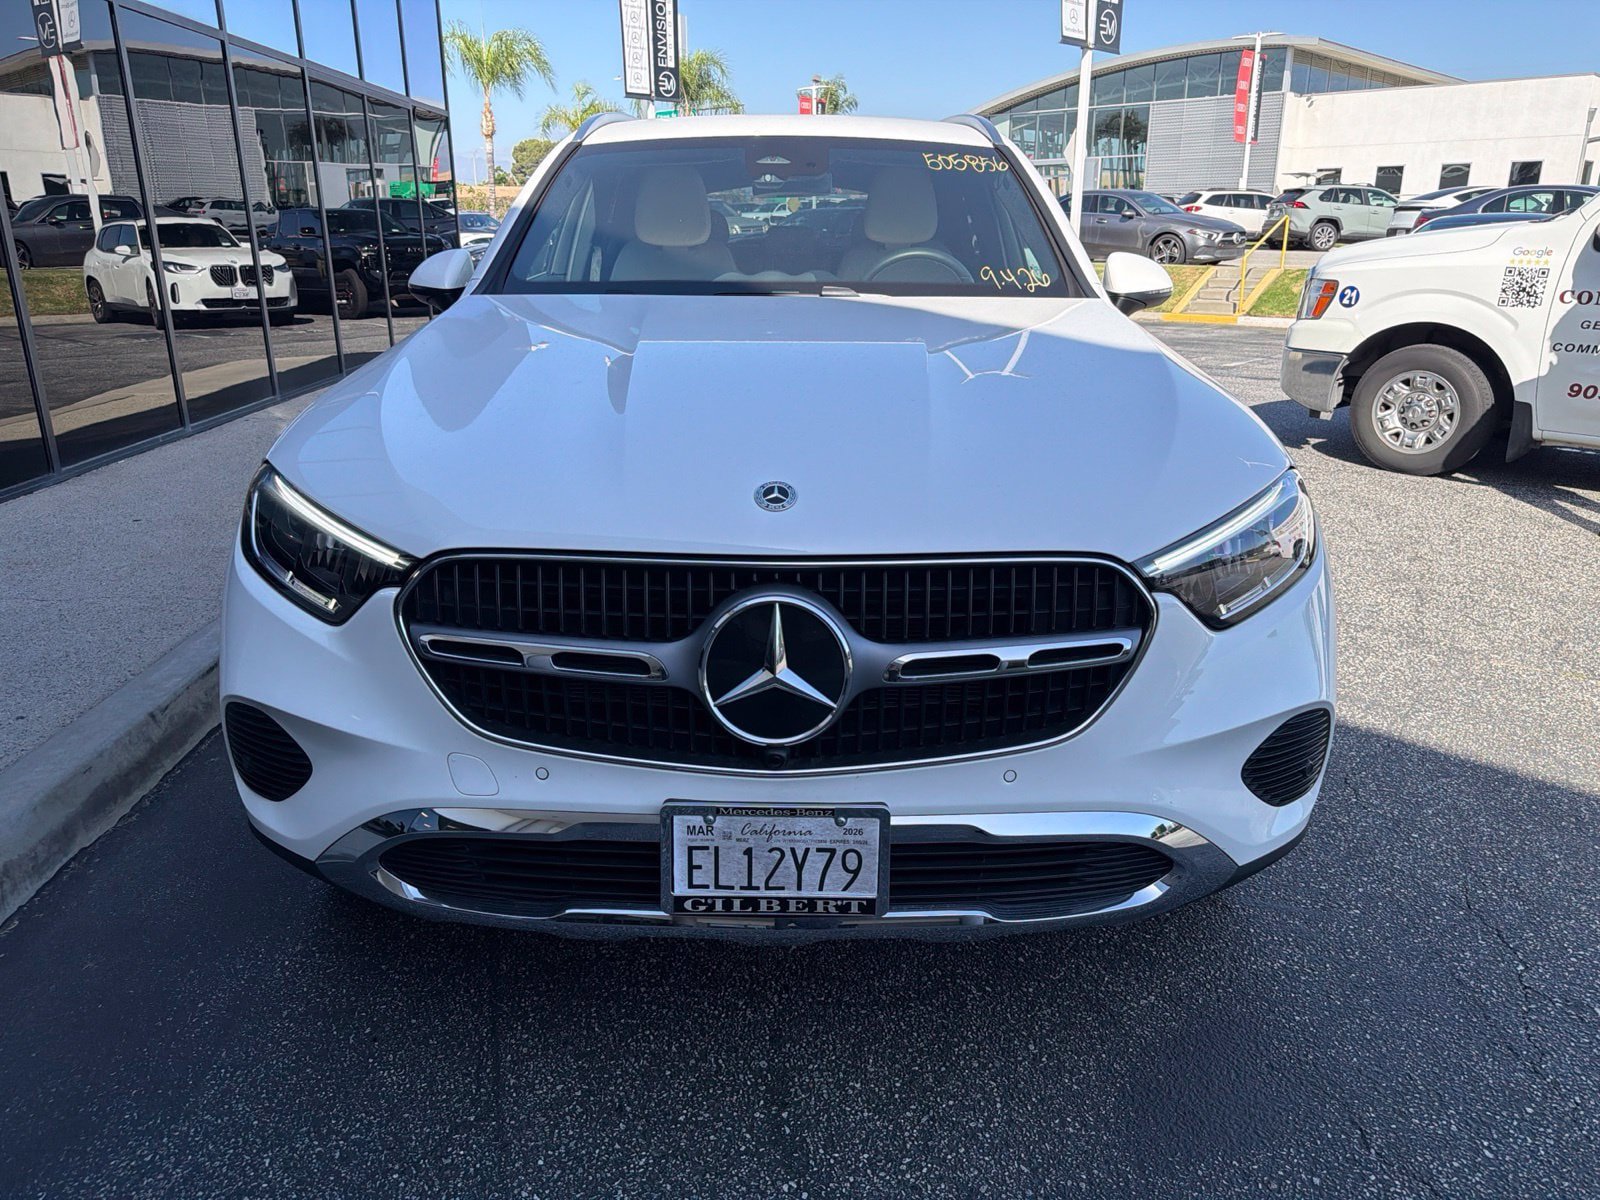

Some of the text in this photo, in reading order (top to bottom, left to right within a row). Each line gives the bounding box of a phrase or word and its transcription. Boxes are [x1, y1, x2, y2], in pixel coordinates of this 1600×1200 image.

[1513, 246, 1553, 259] Google
[1341, 289, 1357, 305] 21
[1567, 382, 1600, 400] 90
[719, 807, 833, 817] Mercedes-Benz
[686, 825, 714, 836] MAR
[741, 822, 813, 843] California
[842, 828, 864, 836] 2026
[687, 845, 864, 892] EL12Y79
[683, 898, 867, 914] GILBERT
